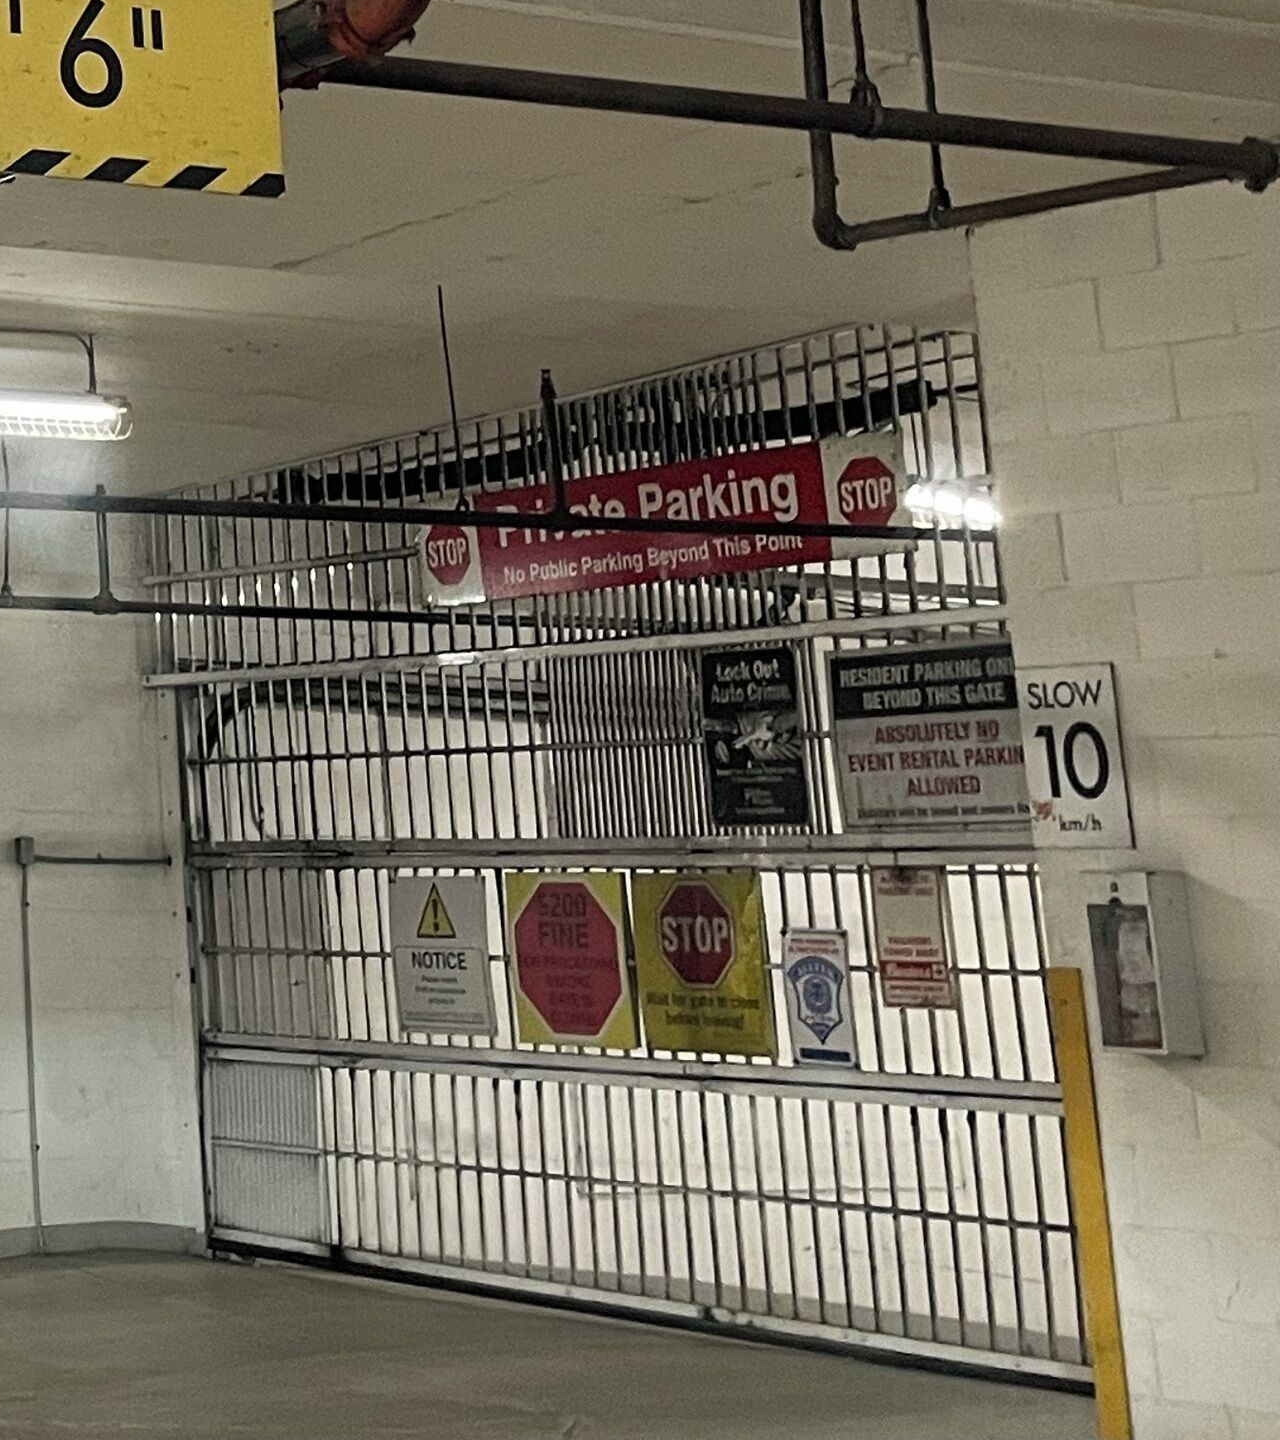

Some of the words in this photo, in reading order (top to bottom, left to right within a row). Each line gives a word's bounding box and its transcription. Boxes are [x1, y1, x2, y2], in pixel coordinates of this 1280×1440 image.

[637, 468, 800, 524] Parking
[840, 476, 892, 512] STOP
[427, 536, 467, 569] STOP
[503, 566, 526, 585] No
[529, 557, 578, 583] Public
[581, 551, 643, 576] Parking
[646, 539, 710, 570] Beyond
[713, 535, 752, 558] This
[755, 533, 803, 552] Point
[840, 664, 911, 688] RESIDENT
[914, 657, 983, 682] PARKING
[985, 656, 1016, 676] ON
[862, 687, 923, 710] BEYOND
[925, 683, 961, 706] THIS
[964, 680, 1008, 704] GATE
[1027, 678, 1102, 710] SLOW
[874, 720, 971, 744] ABSOLUTELY
[976, 719, 1000, 742] NO
[847, 751, 895, 773] EVENT
[899, 748, 962, 770] RENTAL
[964, 744, 1026, 768] PARKIN
[1033, 720, 1110, 800] 10
[906, 774, 982, 797] ALLOWED
[1058, 812, 1102, 832] km/h
[538, 922, 590, 950] FINE
[662, 914, 730, 954] STOP
[410, 950, 468, 971] NOTICE
